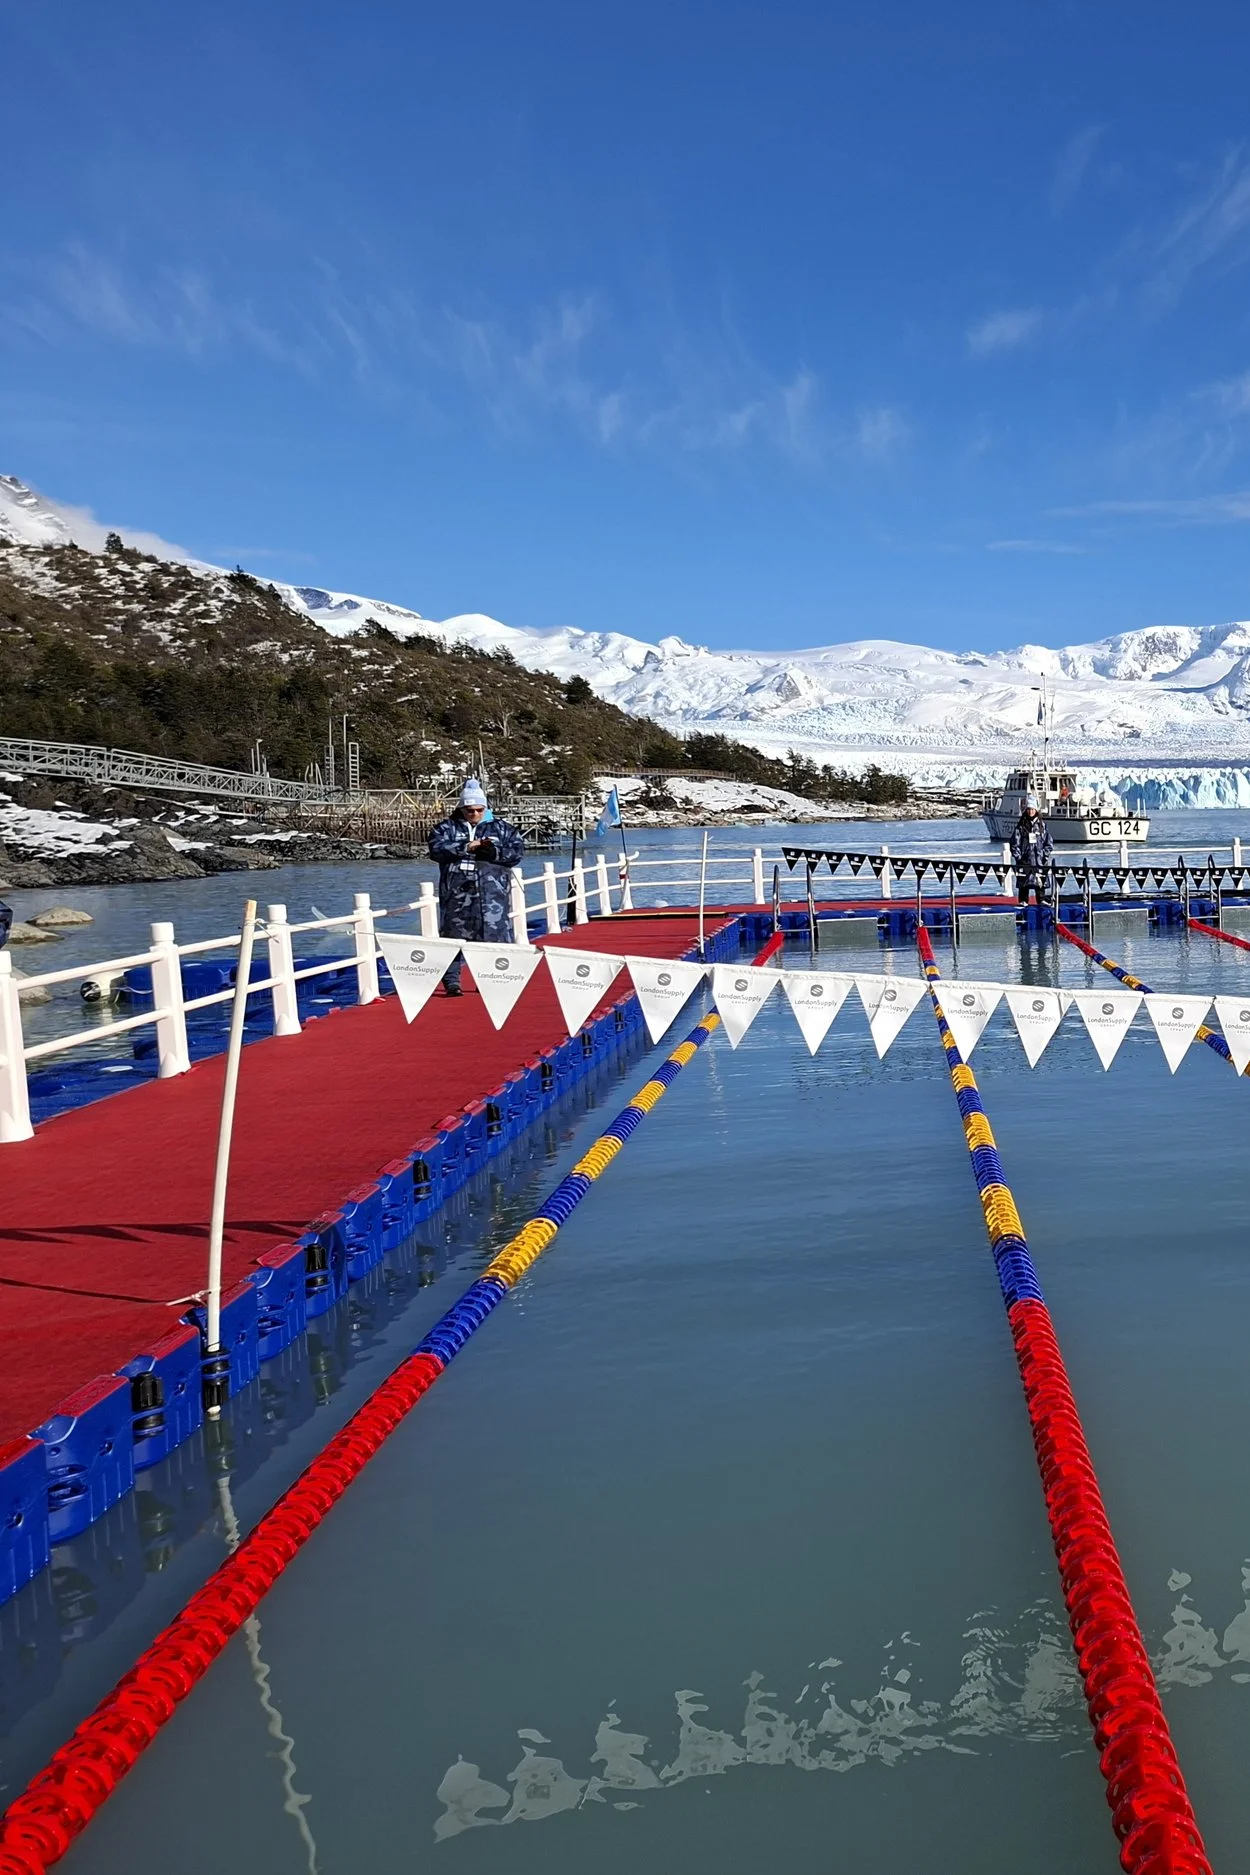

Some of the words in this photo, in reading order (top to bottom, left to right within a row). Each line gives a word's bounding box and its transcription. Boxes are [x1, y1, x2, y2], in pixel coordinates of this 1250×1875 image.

[1089, 821, 1111, 836] GC
[1117, 820, 1140, 835] 124
[393, 964, 441, 975] LondonSupply
[477, 972, 525, 981] LondonSupply
[558, 978, 604, 989] LondonSupply
[640, 986, 686, 997] LondonSupply
[718, 992, 762, 1002] LondonSupply
[794, 999, 837, 1007] LondonSupply
[948, 1008, 989, 1017] LondonSupply
[1017, 1013, 1057, 1022] LondonSupply
[1088, 1017, 1127, 1025] LondonSupply
[1158, 1021, 1196, 1029] LondonSupply
